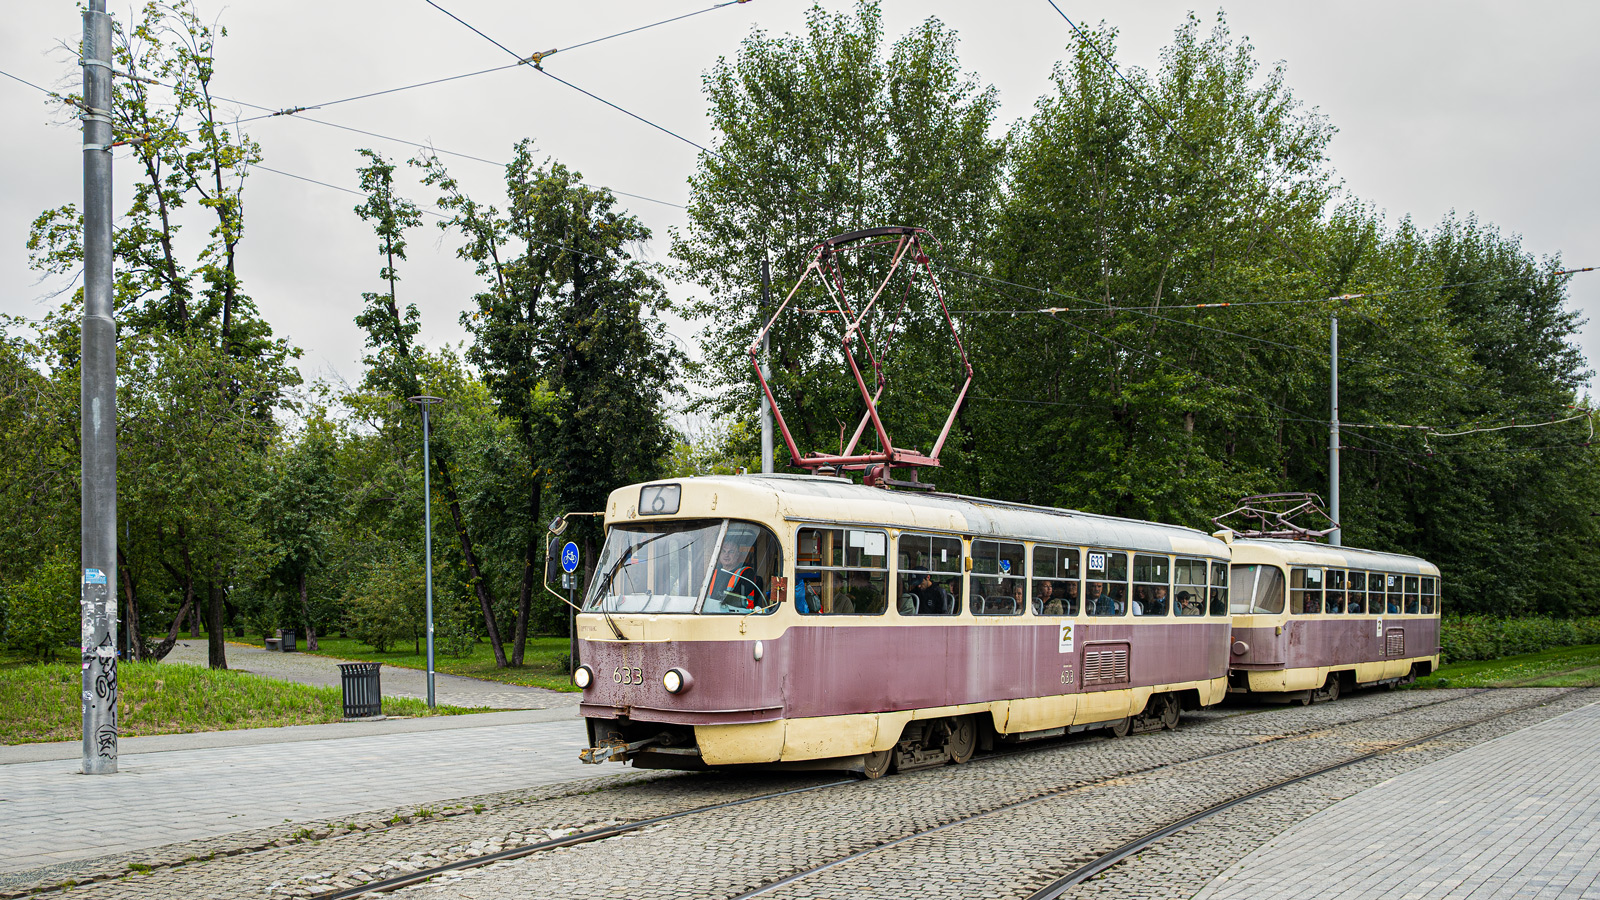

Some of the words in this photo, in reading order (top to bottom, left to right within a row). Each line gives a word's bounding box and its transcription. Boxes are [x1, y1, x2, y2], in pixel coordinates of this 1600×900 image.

[652, 487, 665, 512] 6
[1091, 555, 1103, 568] 633
[613, 666, 643, 685] 633
[1061, 670, 1074, 684] 633
